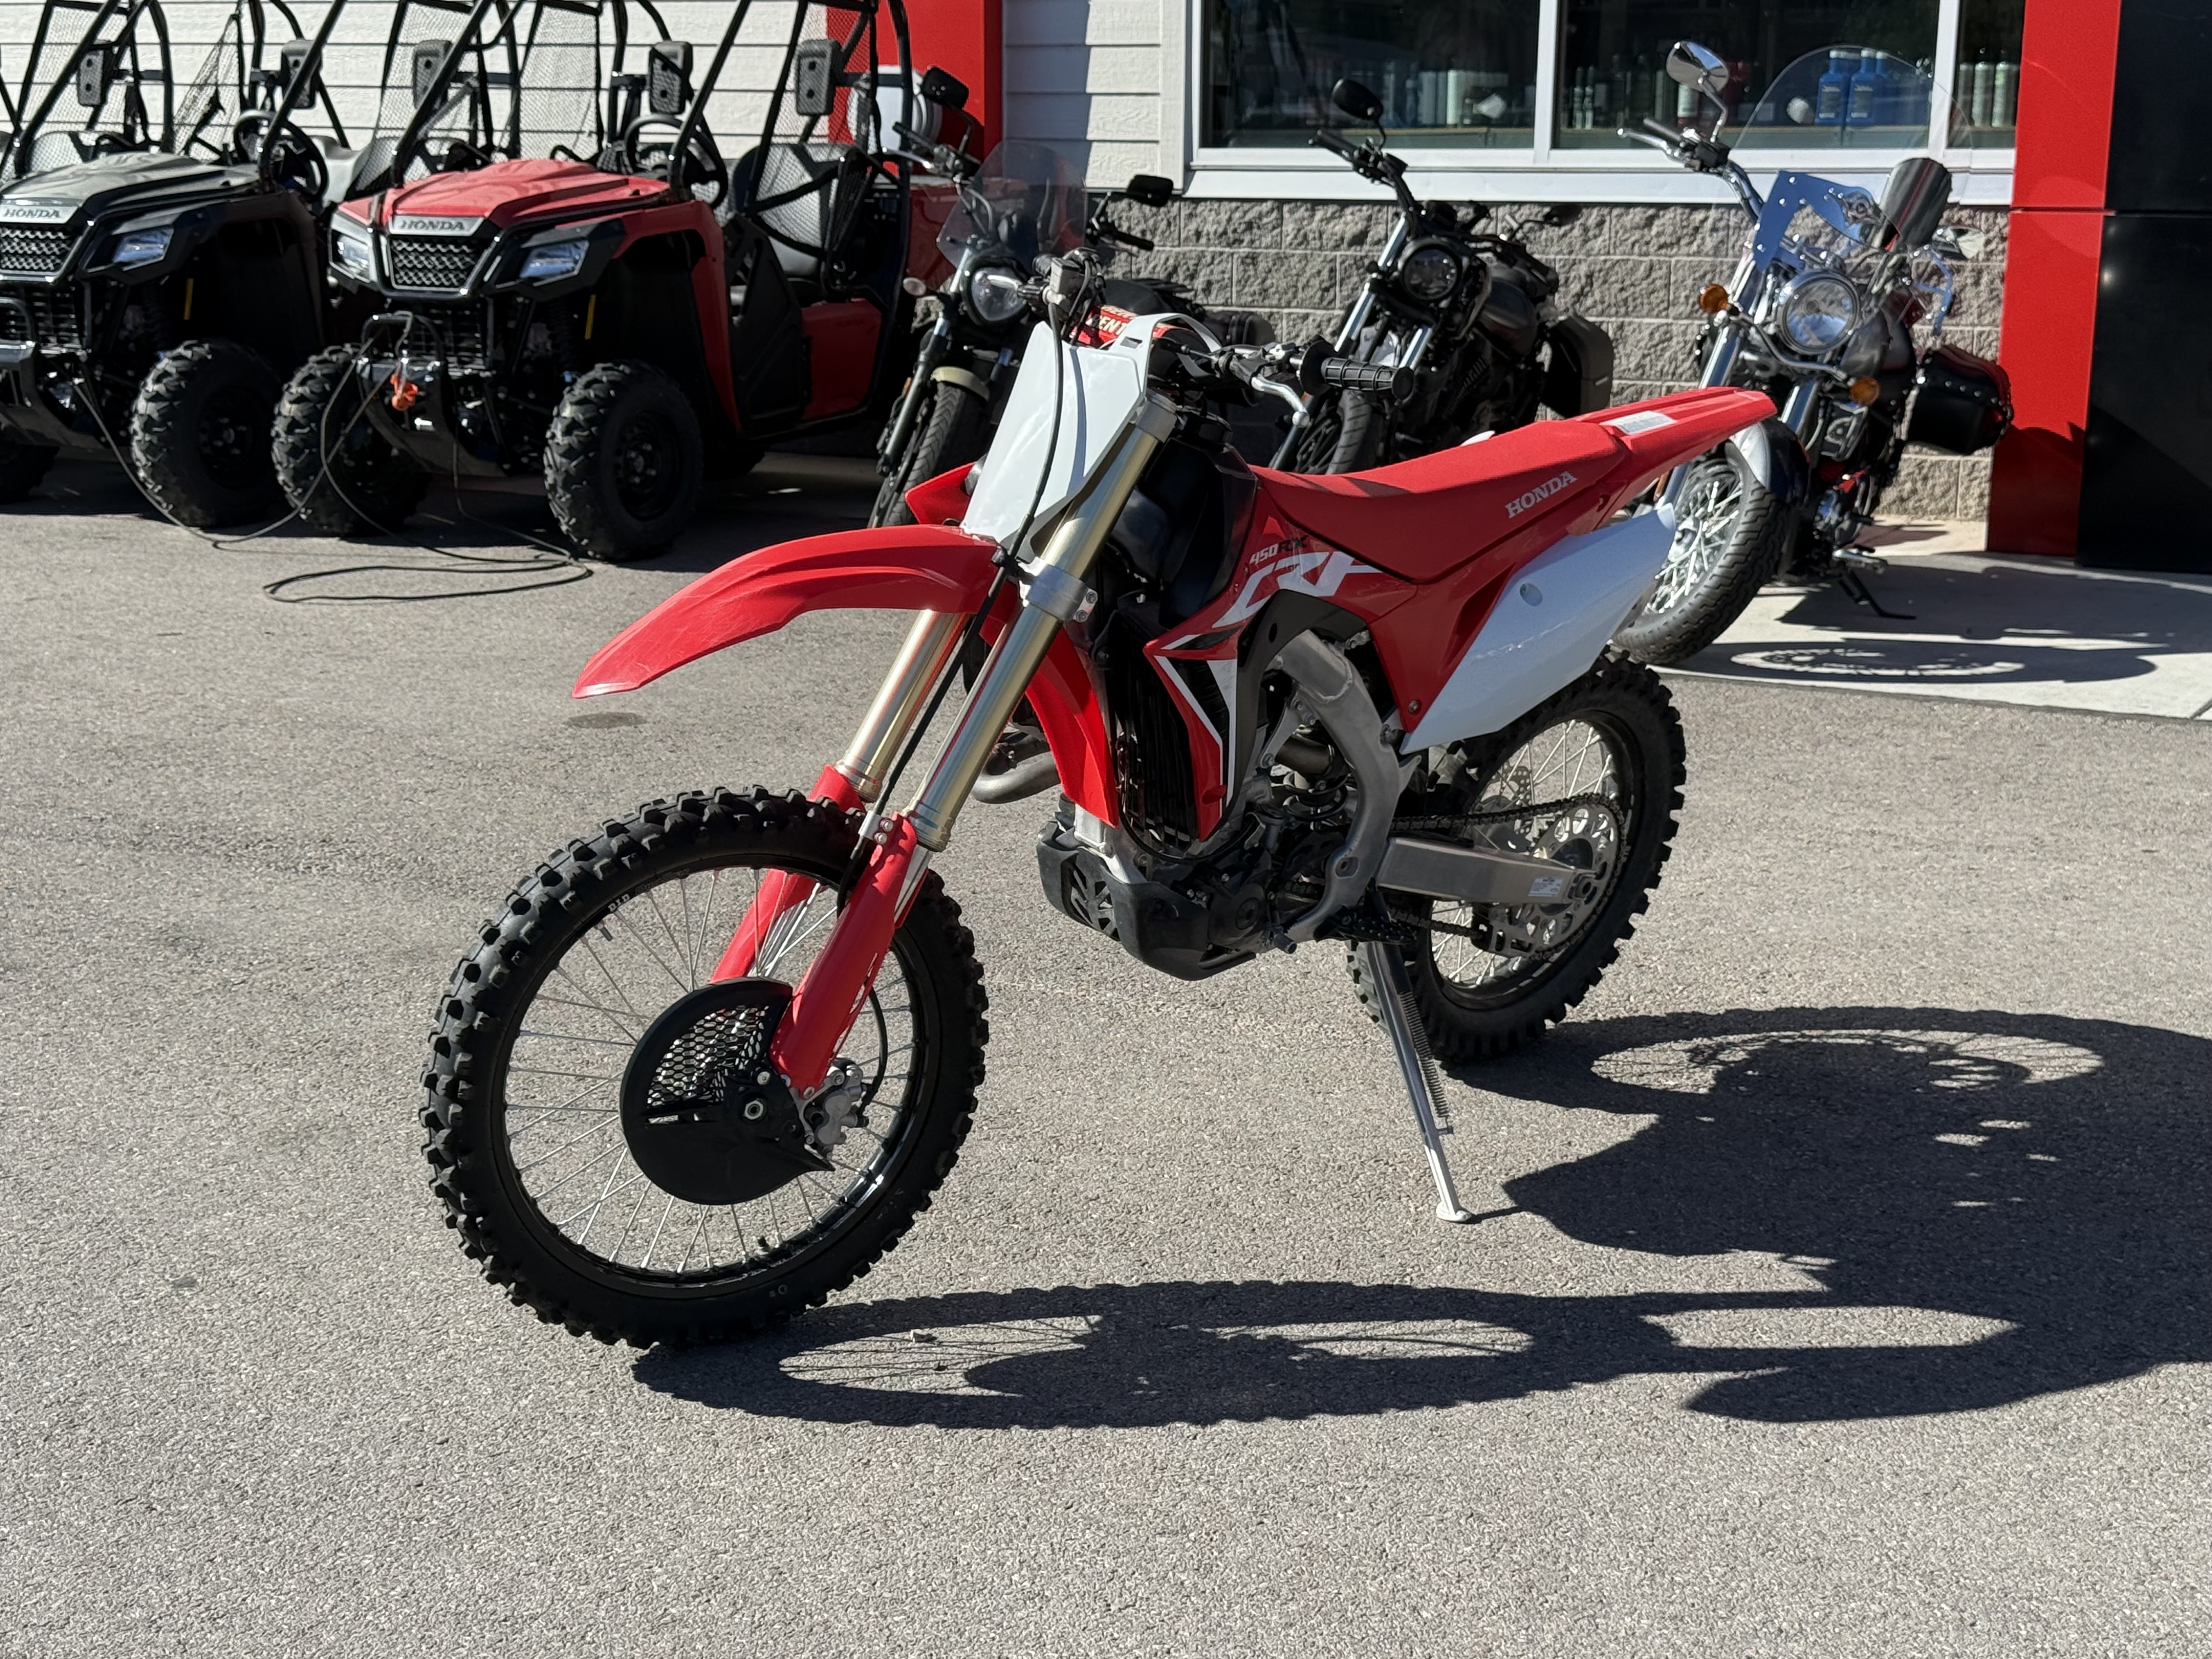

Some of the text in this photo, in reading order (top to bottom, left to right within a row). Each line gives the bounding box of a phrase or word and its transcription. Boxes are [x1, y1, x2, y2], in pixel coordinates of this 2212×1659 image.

[3, 209, 60, 218] HONDA
[398, 221, 465, 231] HONDA
[1505, 471, 1577, 518] HONDA
[1212, 551, 1384, 629] CRF
